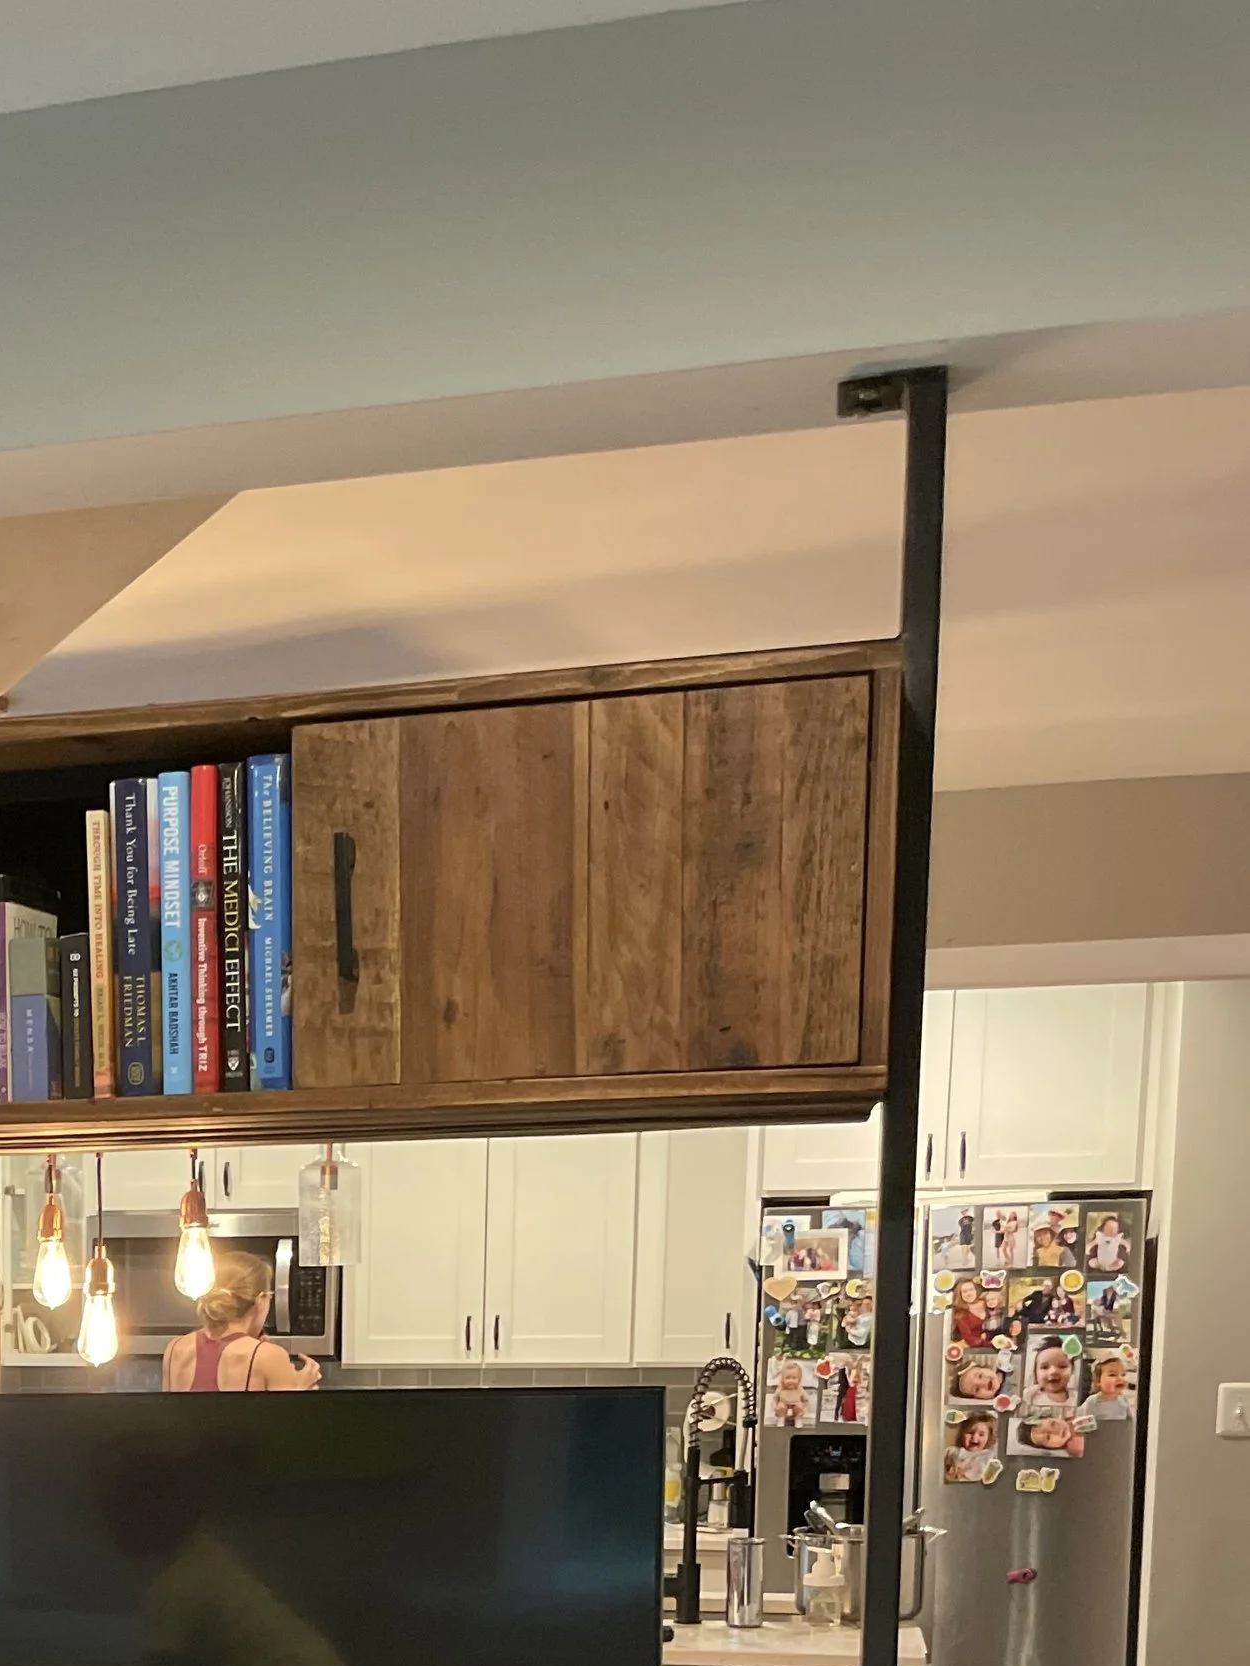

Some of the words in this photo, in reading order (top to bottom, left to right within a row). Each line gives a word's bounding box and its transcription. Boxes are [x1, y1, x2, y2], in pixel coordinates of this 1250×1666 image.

[263, 775, 273, 796] The
[125, 793, 137, 834] Thank
[162, 786, 179, 856] PURPOSE
[93, 821, 101, 871] THROUGH
[126, 839, 137, 862] You
[222, 829, 240, 875] THE
[263, 800, 274, 874] BELIEVING
[127, 866, 138, 885] for
[197, 844, 208, 875] Orloff
[94, 874, 102, 900] TIME
[124, 889, 138, 925] Being
[163, 861, 180, 928] MINDSET
[263, 880, 274, 921] BRAIN
[95, 903, 103, 930] INTO
[224, 880, 242, 952] MEDICI
[95, 934, 104, 979] HEALING
[127, 928, 139, 955] Late
[197, 918, 207, 962] Inventive
[264, 937, 273, 985] MICHAEL
[136, 974, 146, 1033] THOMAS
[167, 972, 178, 1009] AKHTAR
[195, 963, 207, 1004] Thinking
[224, 958, 241, 1032] EFFECT
[123, 975, 134, 1047] FRIEDMAN
[195, 1006, 207, 1044] through
[264, 988, 273, 1037] SHERMER
[168, 1011, 179, 1055] BADSHAH
[197, 1046, 207, 1072] TRIZ
